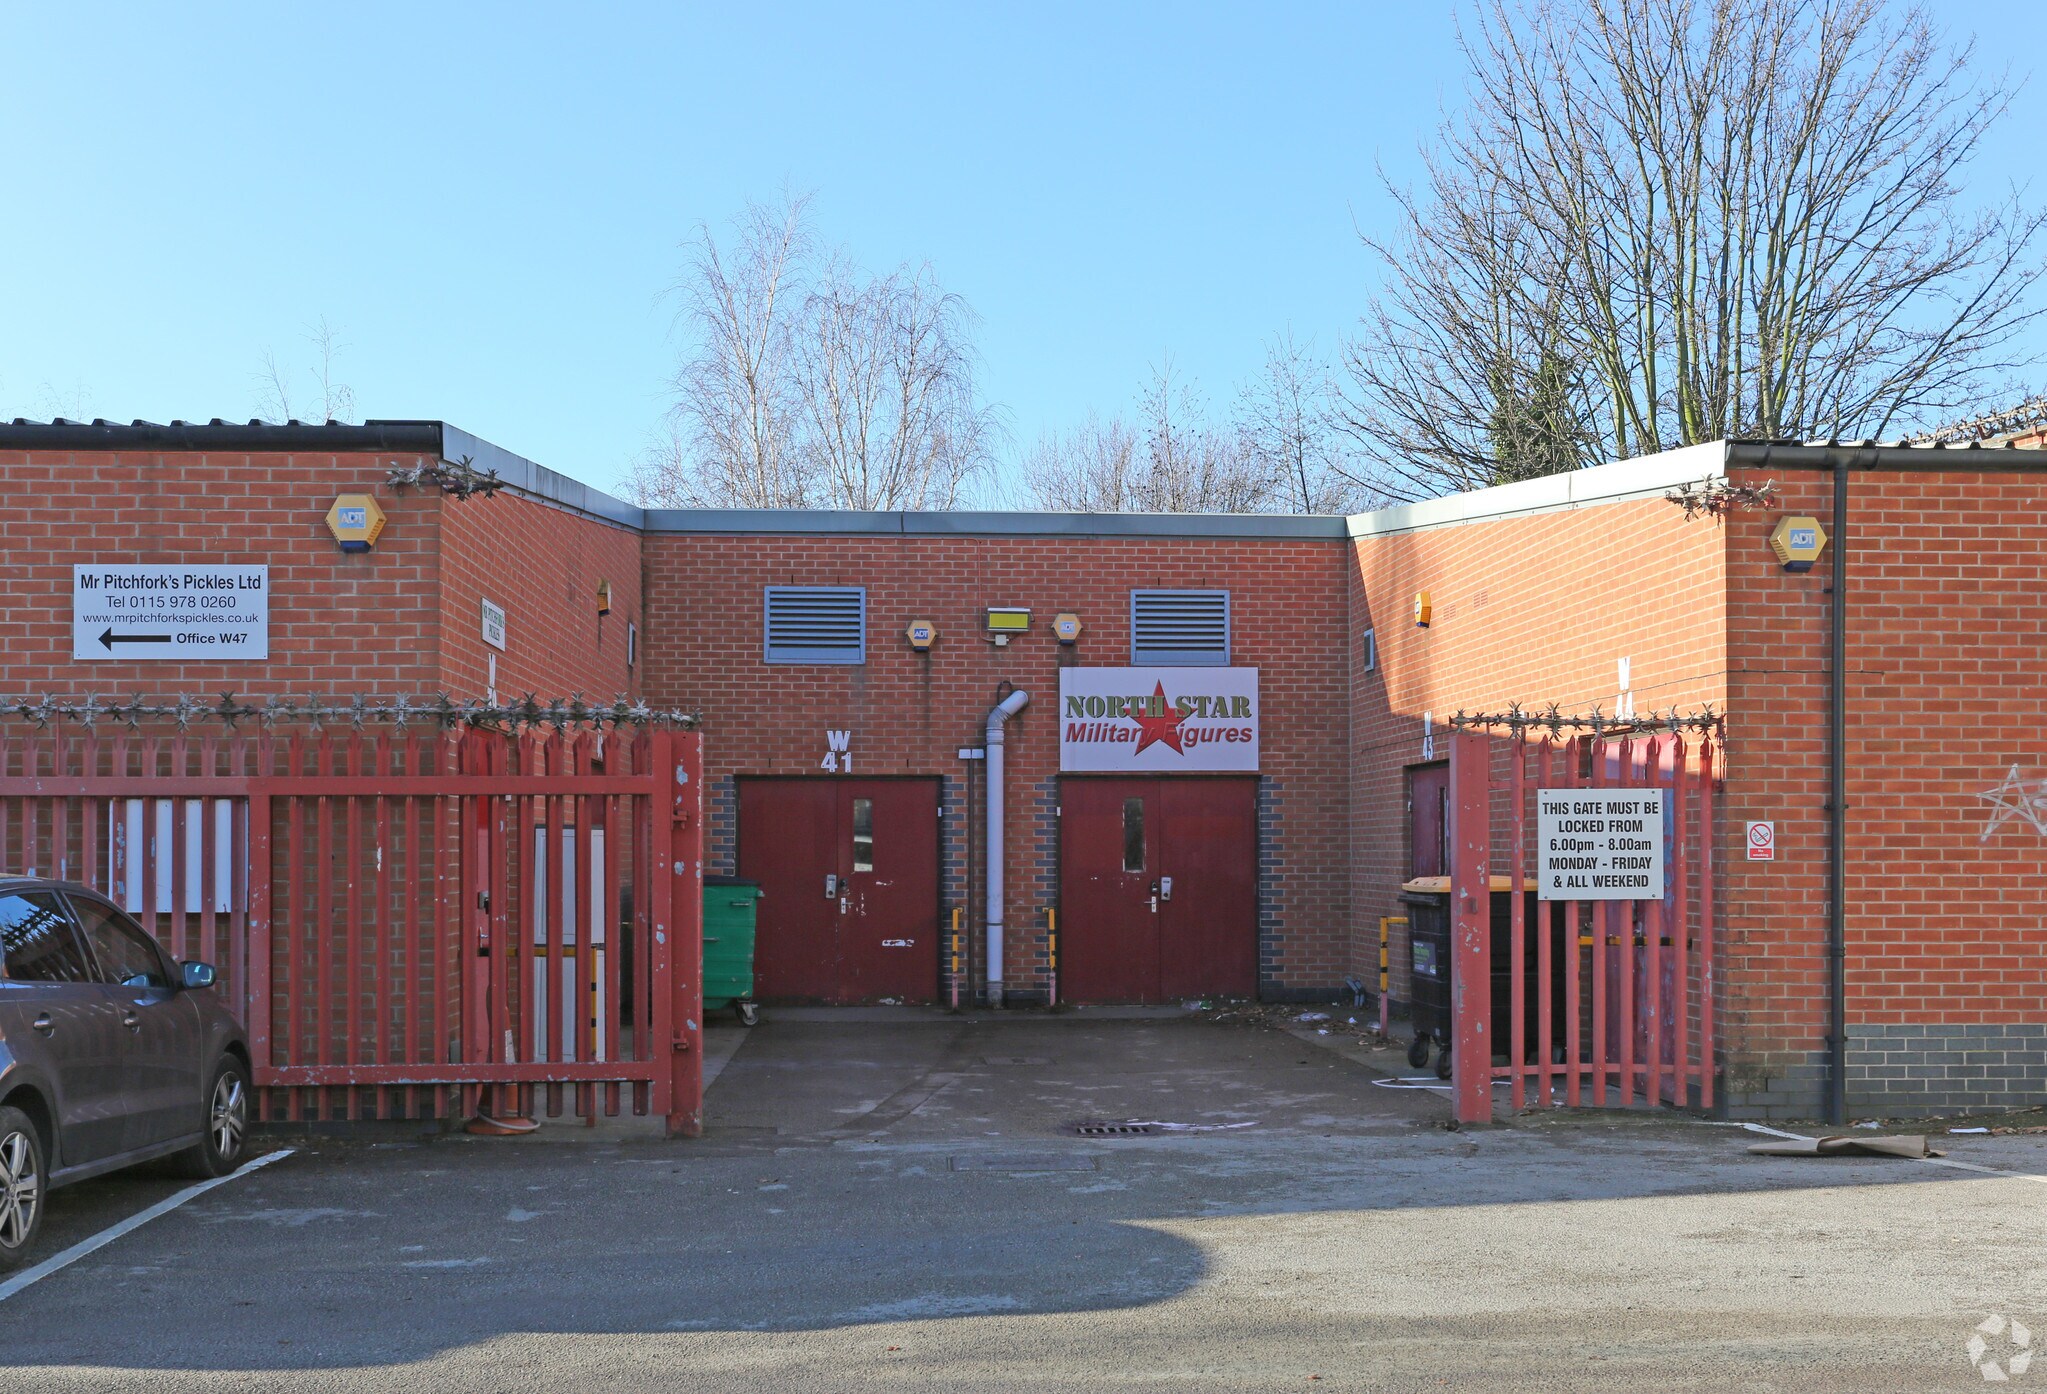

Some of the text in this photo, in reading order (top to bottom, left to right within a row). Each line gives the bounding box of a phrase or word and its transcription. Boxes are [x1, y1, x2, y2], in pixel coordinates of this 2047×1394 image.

[341, 511, 366, 525] ADT
[1791, 532, 1815, 545] ADT
[80, 574, 261, 589] Mr Pitchfork's Pickles Ltd
[105, 595, 236, 608] Tel 0115 978 0260
[83, 613, 259, 625] www.mrpitchforkspickles.co.uk
[176, 632, 247, 644] Office W47
[914, 630, 929, 639] ADT
[1065, 695, 1252, 718] NORTH STAR
[827, 730, 850, 751] W
[1065, 722, 1253, 748] Military Figures
[821, 752, 851, 772] 41
[1543, 802, 1658, 815] THIS GATE MUST BE
[1558, 820, 1643, 833] LOCKED FROM
[1550, 838, 1594, 853] 6.00pm
[1608, 838, 1652, 851] 8.00am
[1549, 857, 1598, 870] MONDAY
[1612, 857, 1652, 869] FRIDAY
[1553, 875, 1649, 888] & ALL WEEKEND
